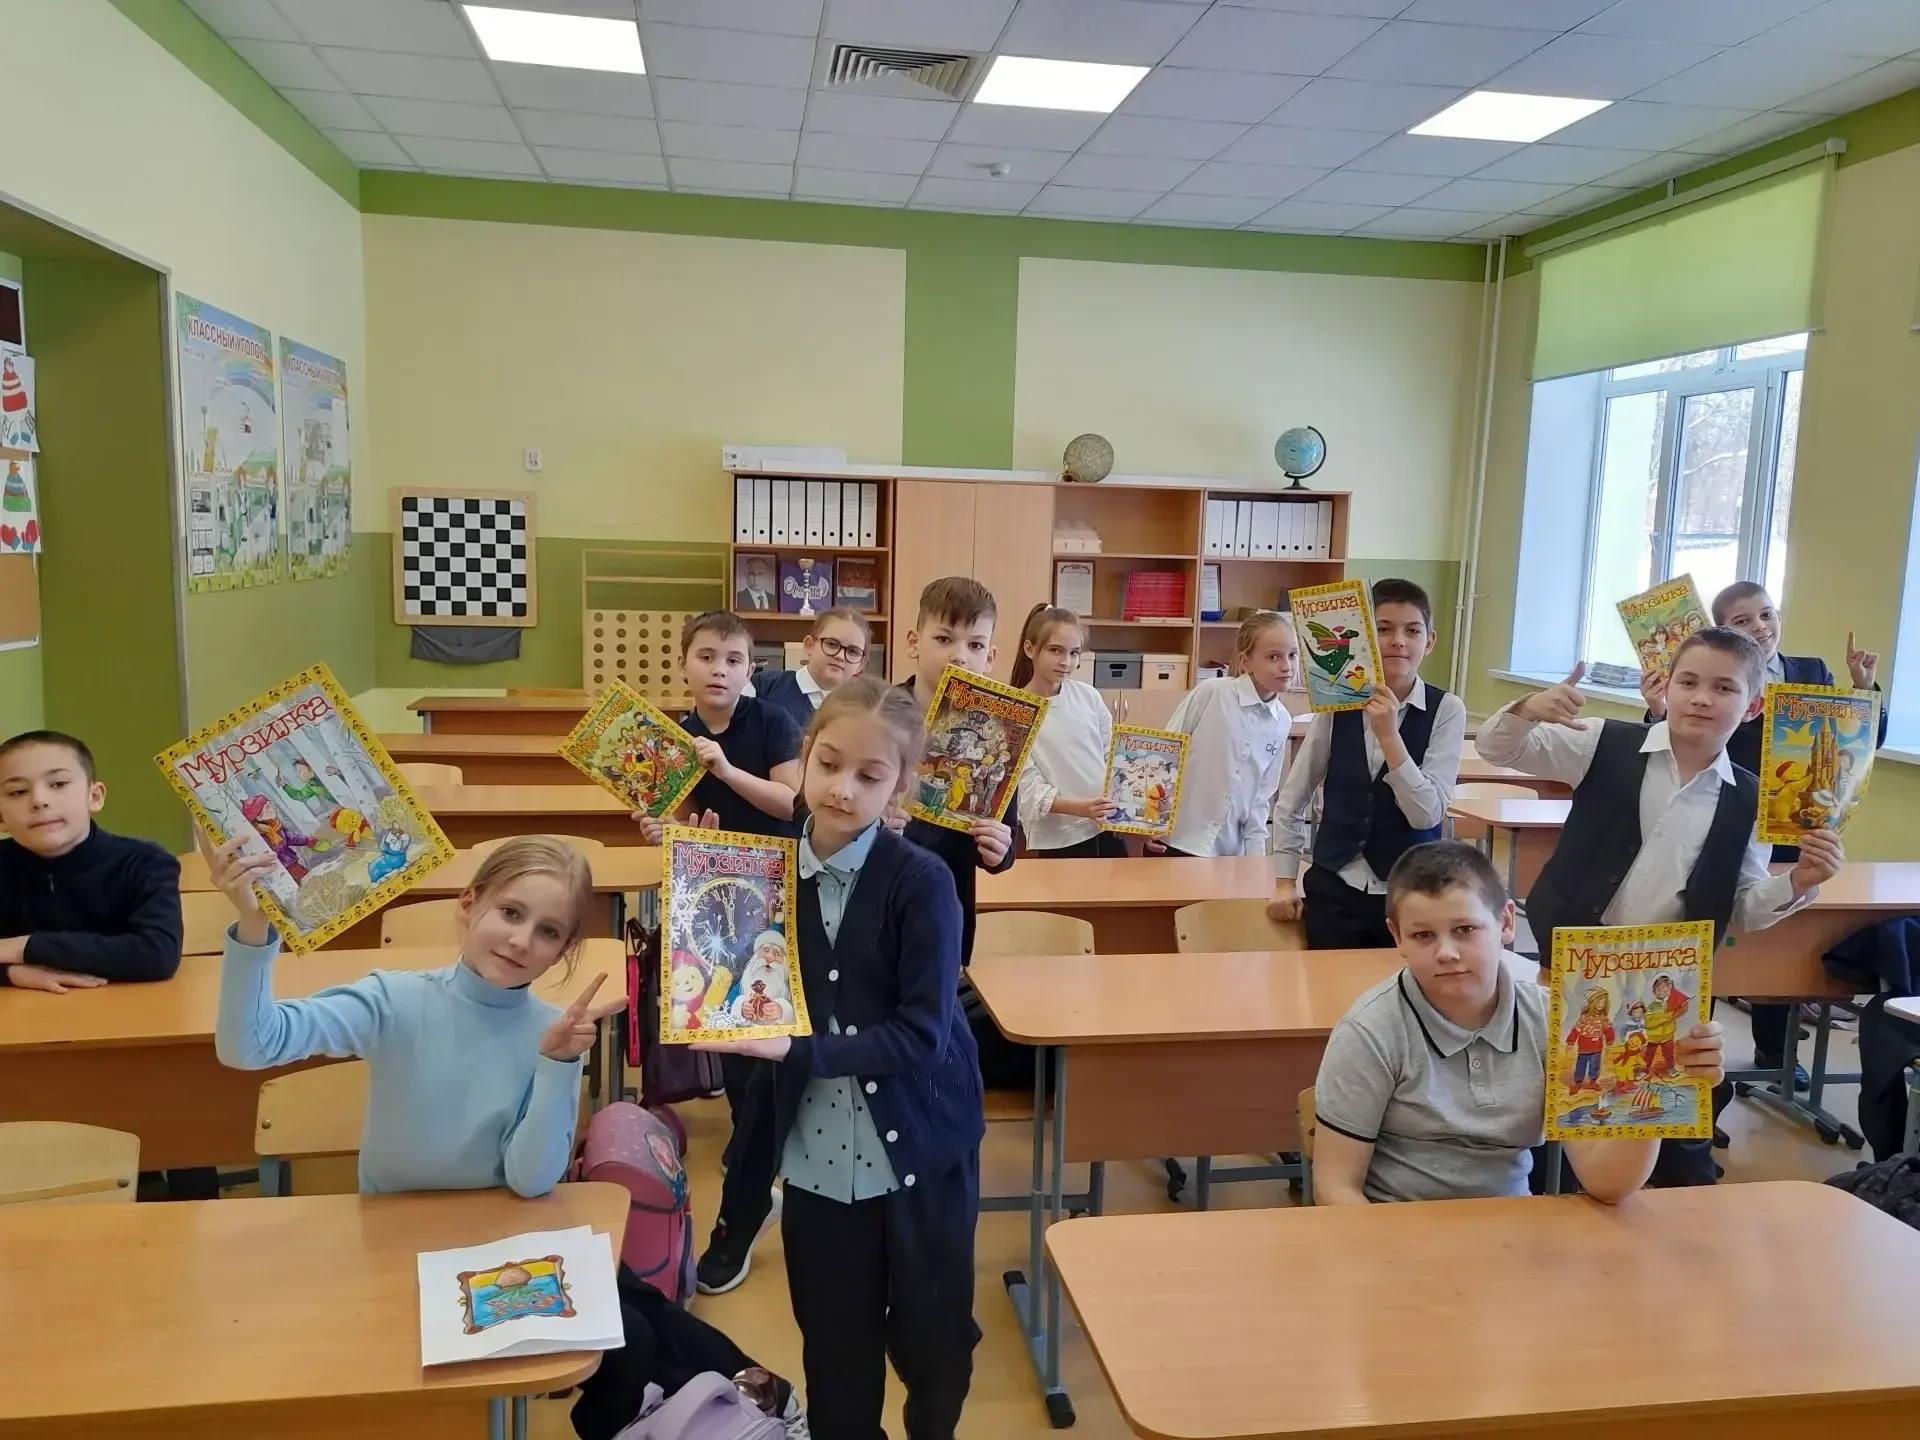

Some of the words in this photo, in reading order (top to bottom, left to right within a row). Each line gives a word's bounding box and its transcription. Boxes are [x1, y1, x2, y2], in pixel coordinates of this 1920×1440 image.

[187, 316, 235, 349] КЛАССНЫЙ
[1294, 596, 1359, 618] Мурзилка
[1622, 585, 1688, 617] Мурзилка
[179, 696, 333, 789] Мурзилка
[1118, 733, 1179, 754] Мурзилка
[674, 843, 784, 877] Мурзилка
[1566, 947, 1698, 979] Мурзилка
